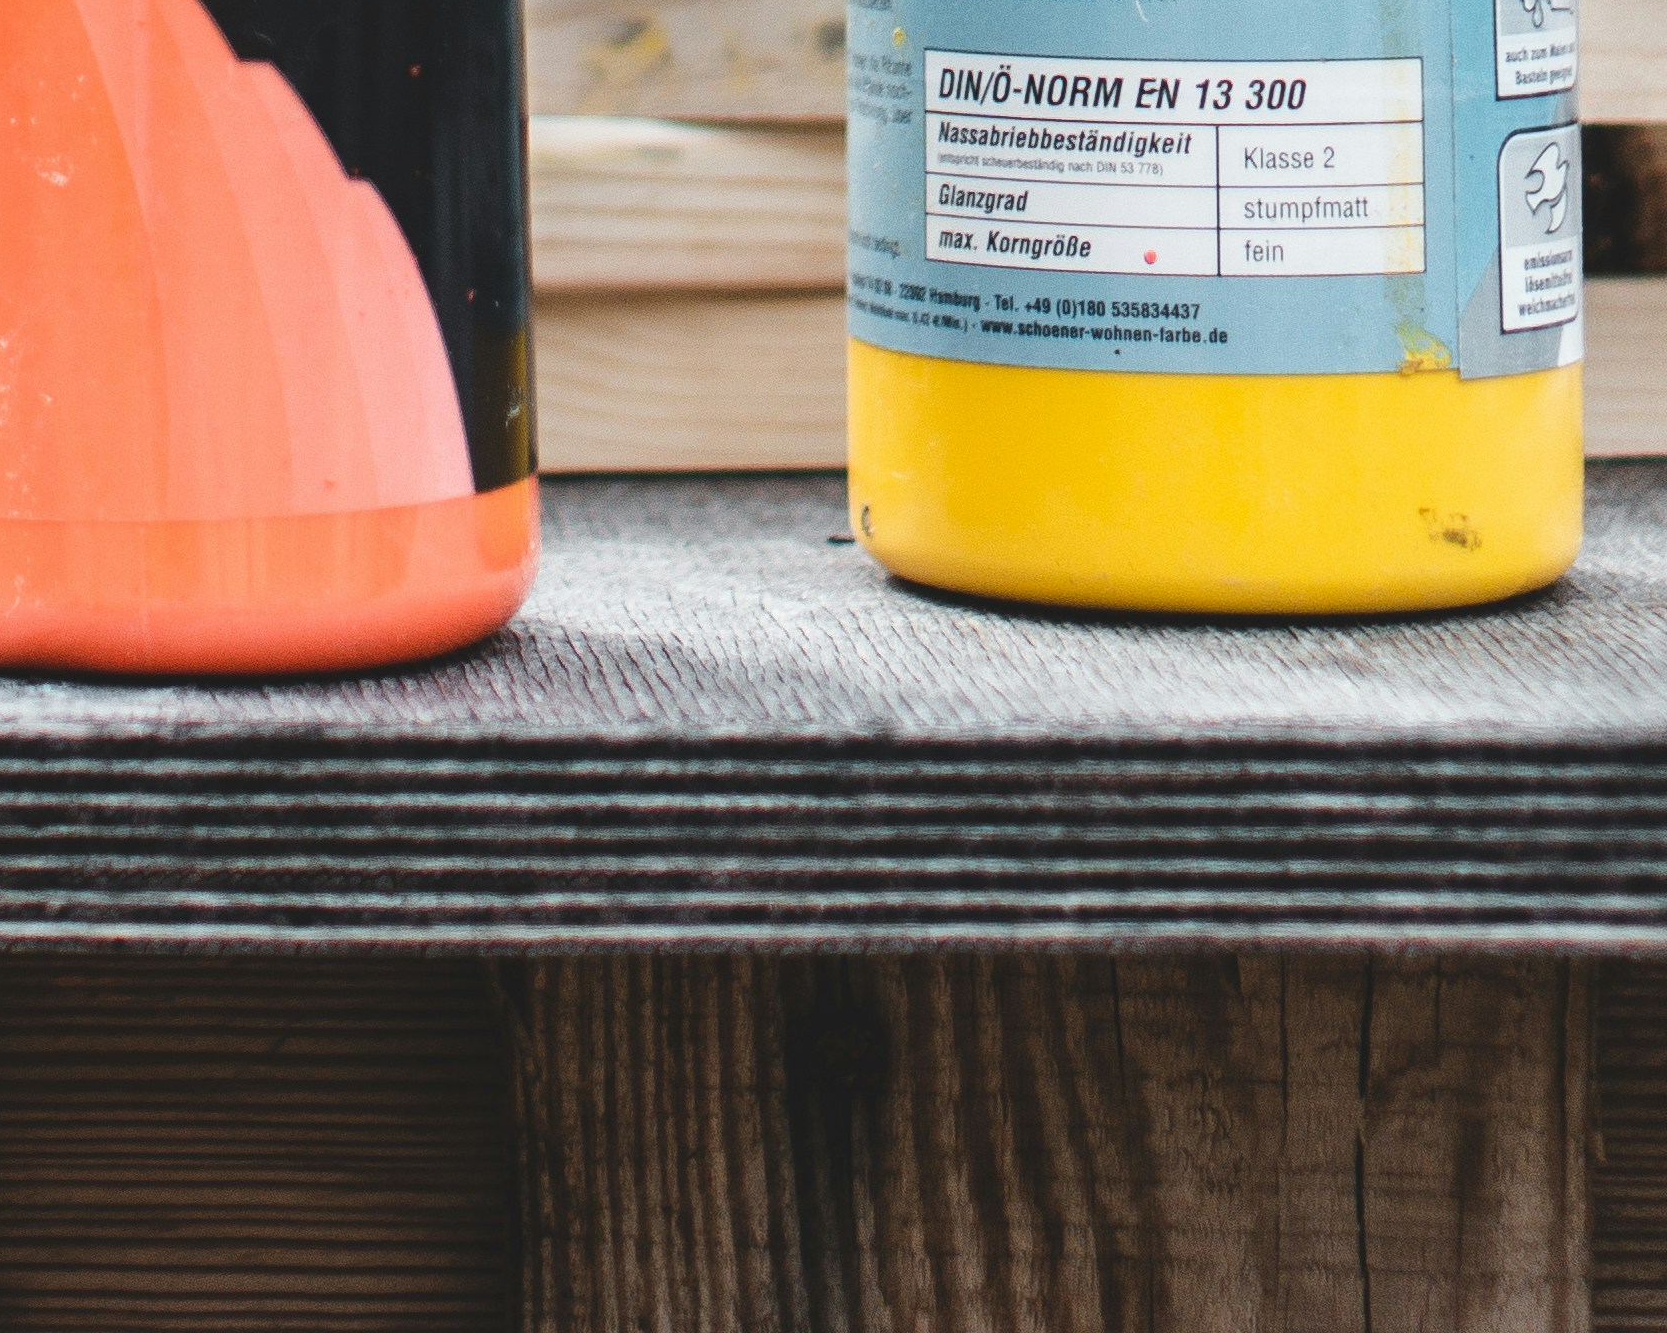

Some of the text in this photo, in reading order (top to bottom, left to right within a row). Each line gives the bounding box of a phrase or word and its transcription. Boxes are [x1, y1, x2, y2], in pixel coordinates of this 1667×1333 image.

[938, 65, 1124, 108] DIN/Ö-NORM
[1134, 78, 1181, 110] EN
[1195, 80, 1234, 111] 13
[1244, 79, 1307, 111] 300
[937, 122, 1192, 158] Nassabriebbeständigkeit
[1067, 162, 1093, 173] nach
[1096, 160, 1117, 174] DIN
[1120, 161, 1135, 175] 53
[1243, 146, 1336, 170] Klasse 2
[938, 183, 1029, 215] Glanzgrad
[1243, 197, 1369, 223] stumpfmatt
[938, 230, 1092, 261] max. Korngröße
[1244, 240, 1285, 263] fein
[993, 294, 1020, 312] Tel.
[1024, 297, 1052, 315] +49
[1055, 298, 1106, 320] (0)180
[1111, 301, 1201, 320] 535834437
[979, 321, 1229, 345] www.schoener-wohnen-farbe.de
